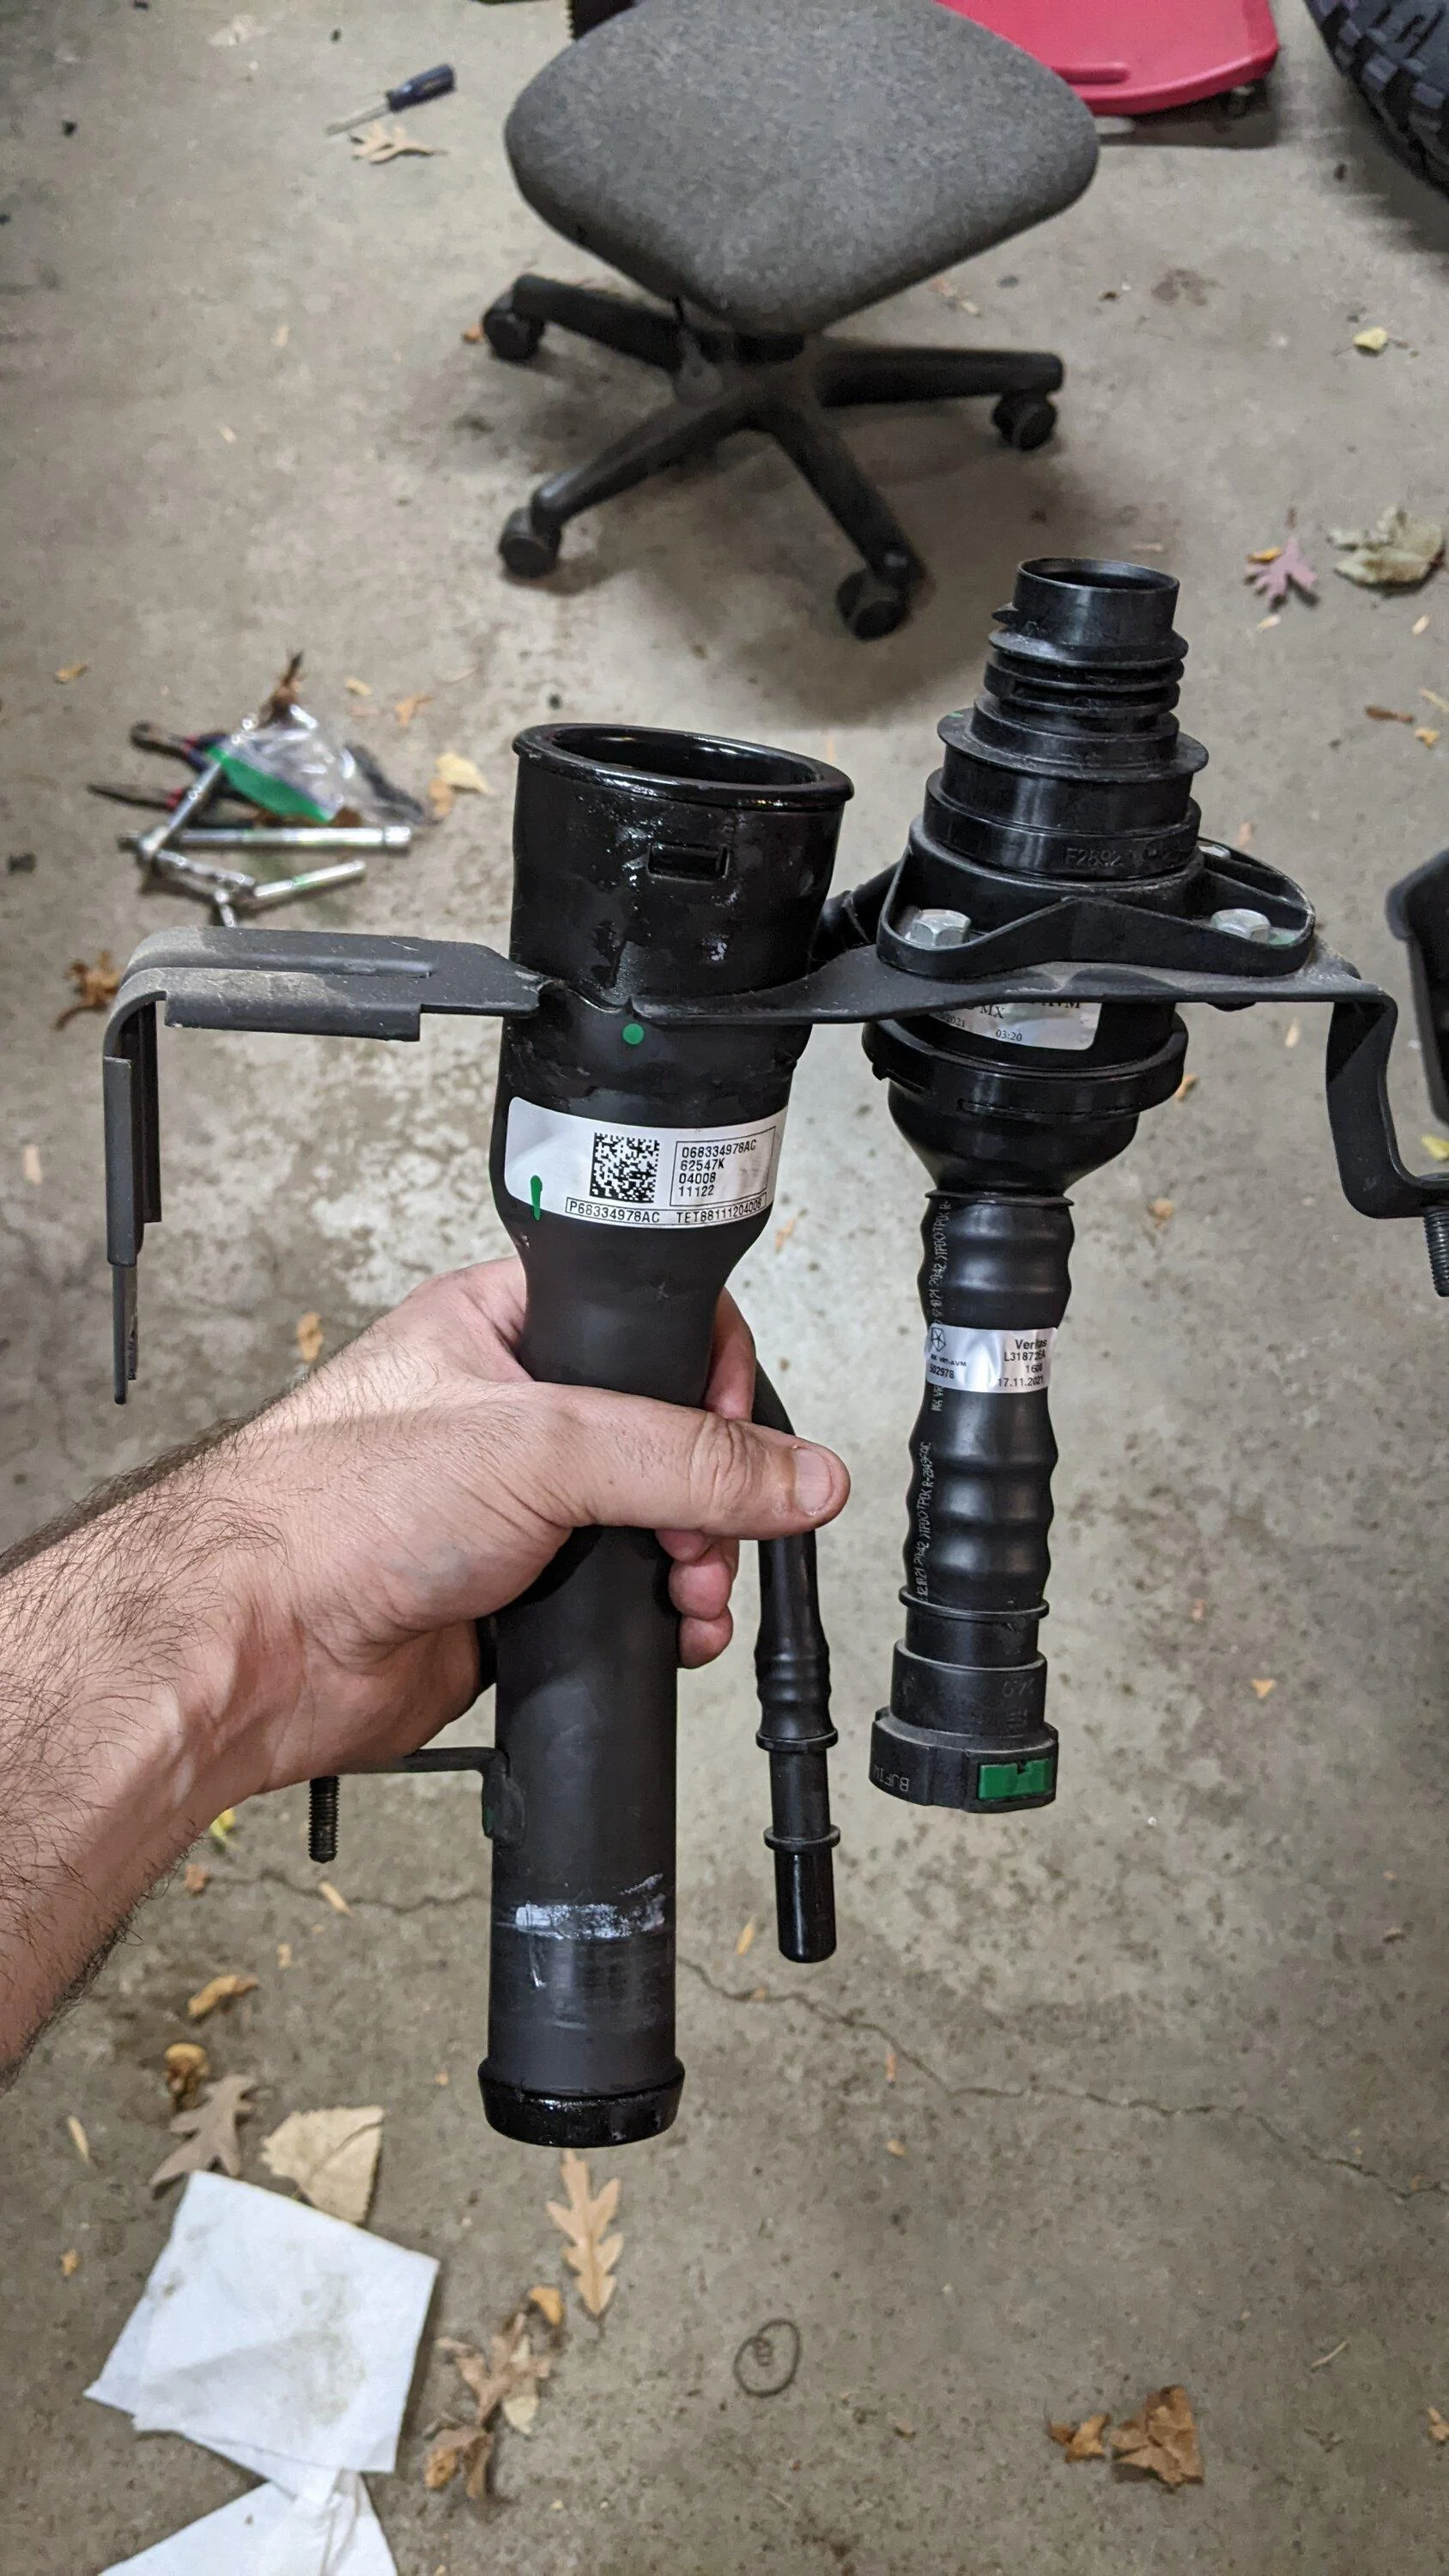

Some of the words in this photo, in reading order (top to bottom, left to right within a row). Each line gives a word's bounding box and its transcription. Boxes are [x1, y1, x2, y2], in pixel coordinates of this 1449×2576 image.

[995, 1029, 1023, 1042] 03:20
[680, 1157, 725, 1171] 62547K
[678, 1172, 717, 1184] 04008
[678, 1185, 715, 1197] 11122
[569, 1200, 660, 1223] P68334978AC
[998, 1374, 1044, 1387] 17.11.2021
